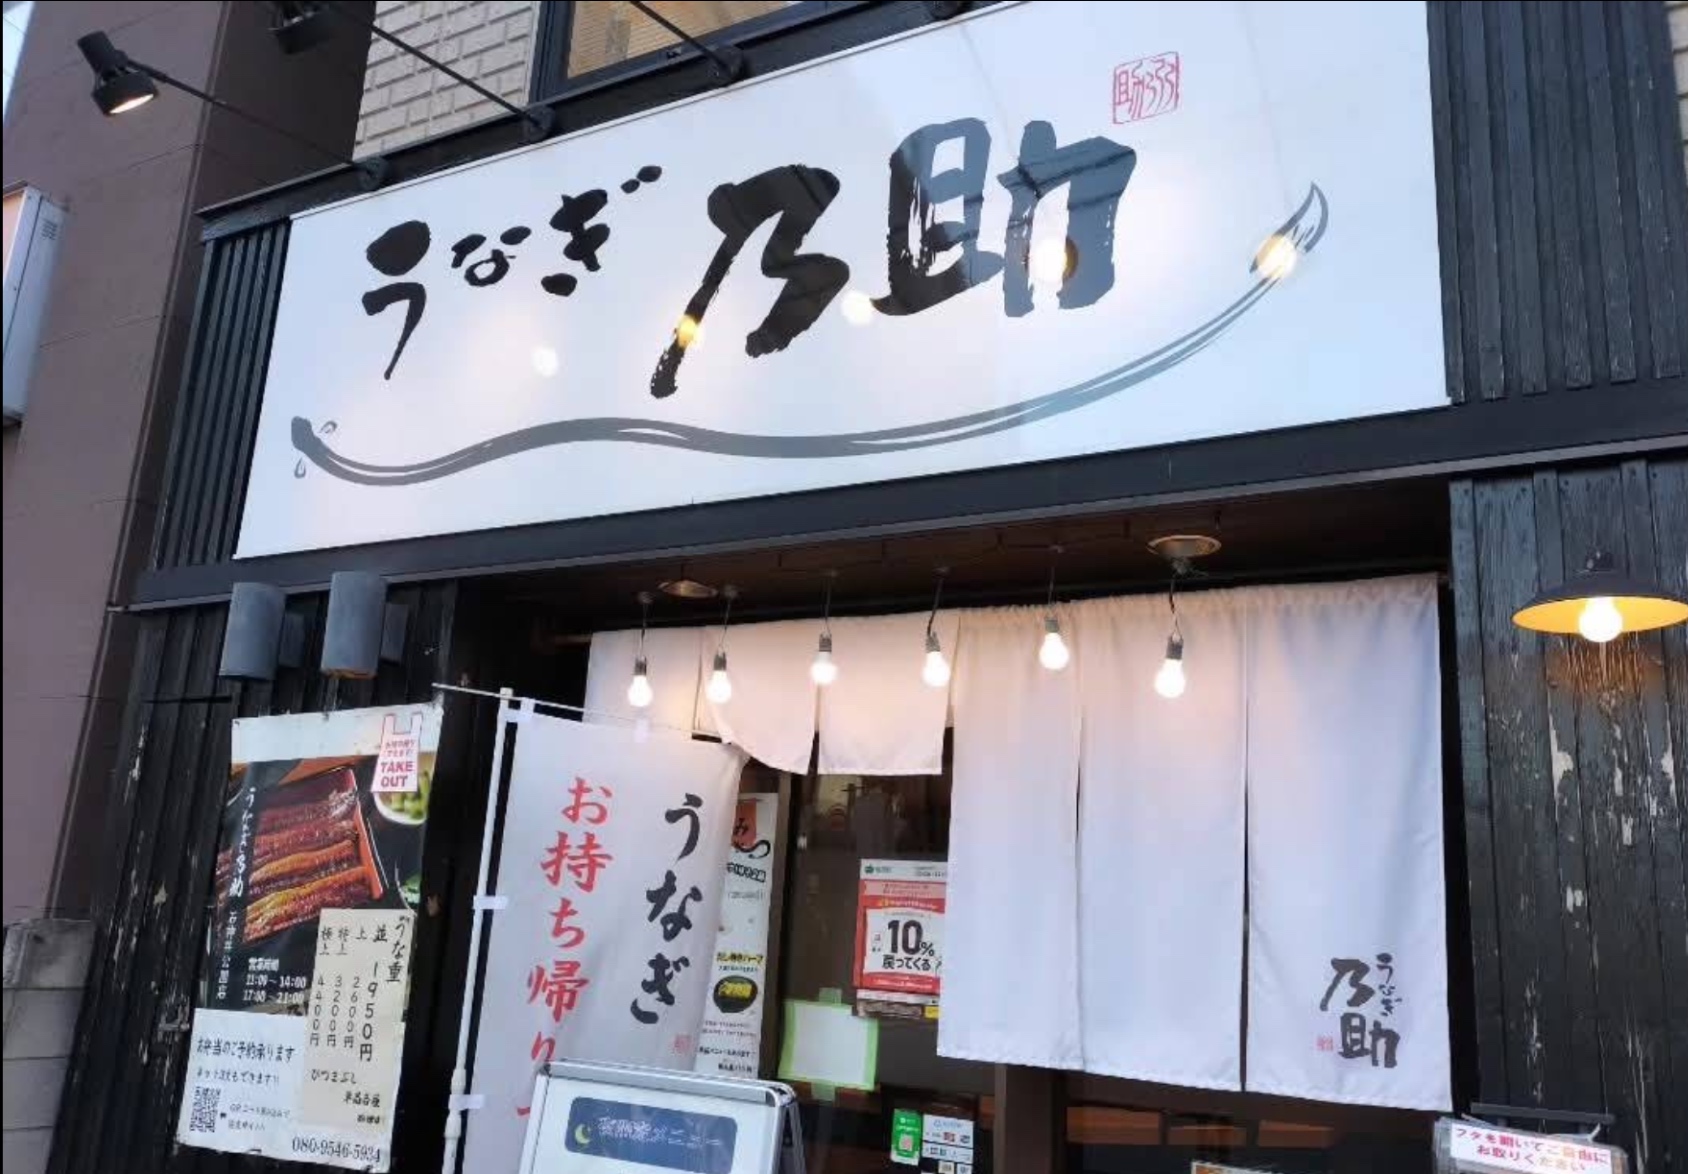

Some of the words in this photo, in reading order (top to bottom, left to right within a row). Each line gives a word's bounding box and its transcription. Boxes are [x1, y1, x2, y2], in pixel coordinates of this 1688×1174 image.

[362, 164, 662, 380] うなぎ
[648, 116, 1137, 399] 乃助
[381, 761, 414, 773] TAKE
[381, 776, 408, 787] OUT
[355, 925, 368, 941] 上
[372, 924, 389, 943] 並
[630, 792, 703, 1025] うなぎ
[887, 919, 936, 957] 10%
[385, 915, 411, 983] うな重
[517, 776, 614, 1116] お持ち帰り
[309, 975, 326, 1047] 4400円
[326, 975, 344, 1048] 3200円
[343, 976, 361, 1049] 2600円
[359, 961, 379, 1063] 1950円
[1319, 957, 1401, 1069] 乃助
[1375, 952, 1403, 1017] うなぎ
